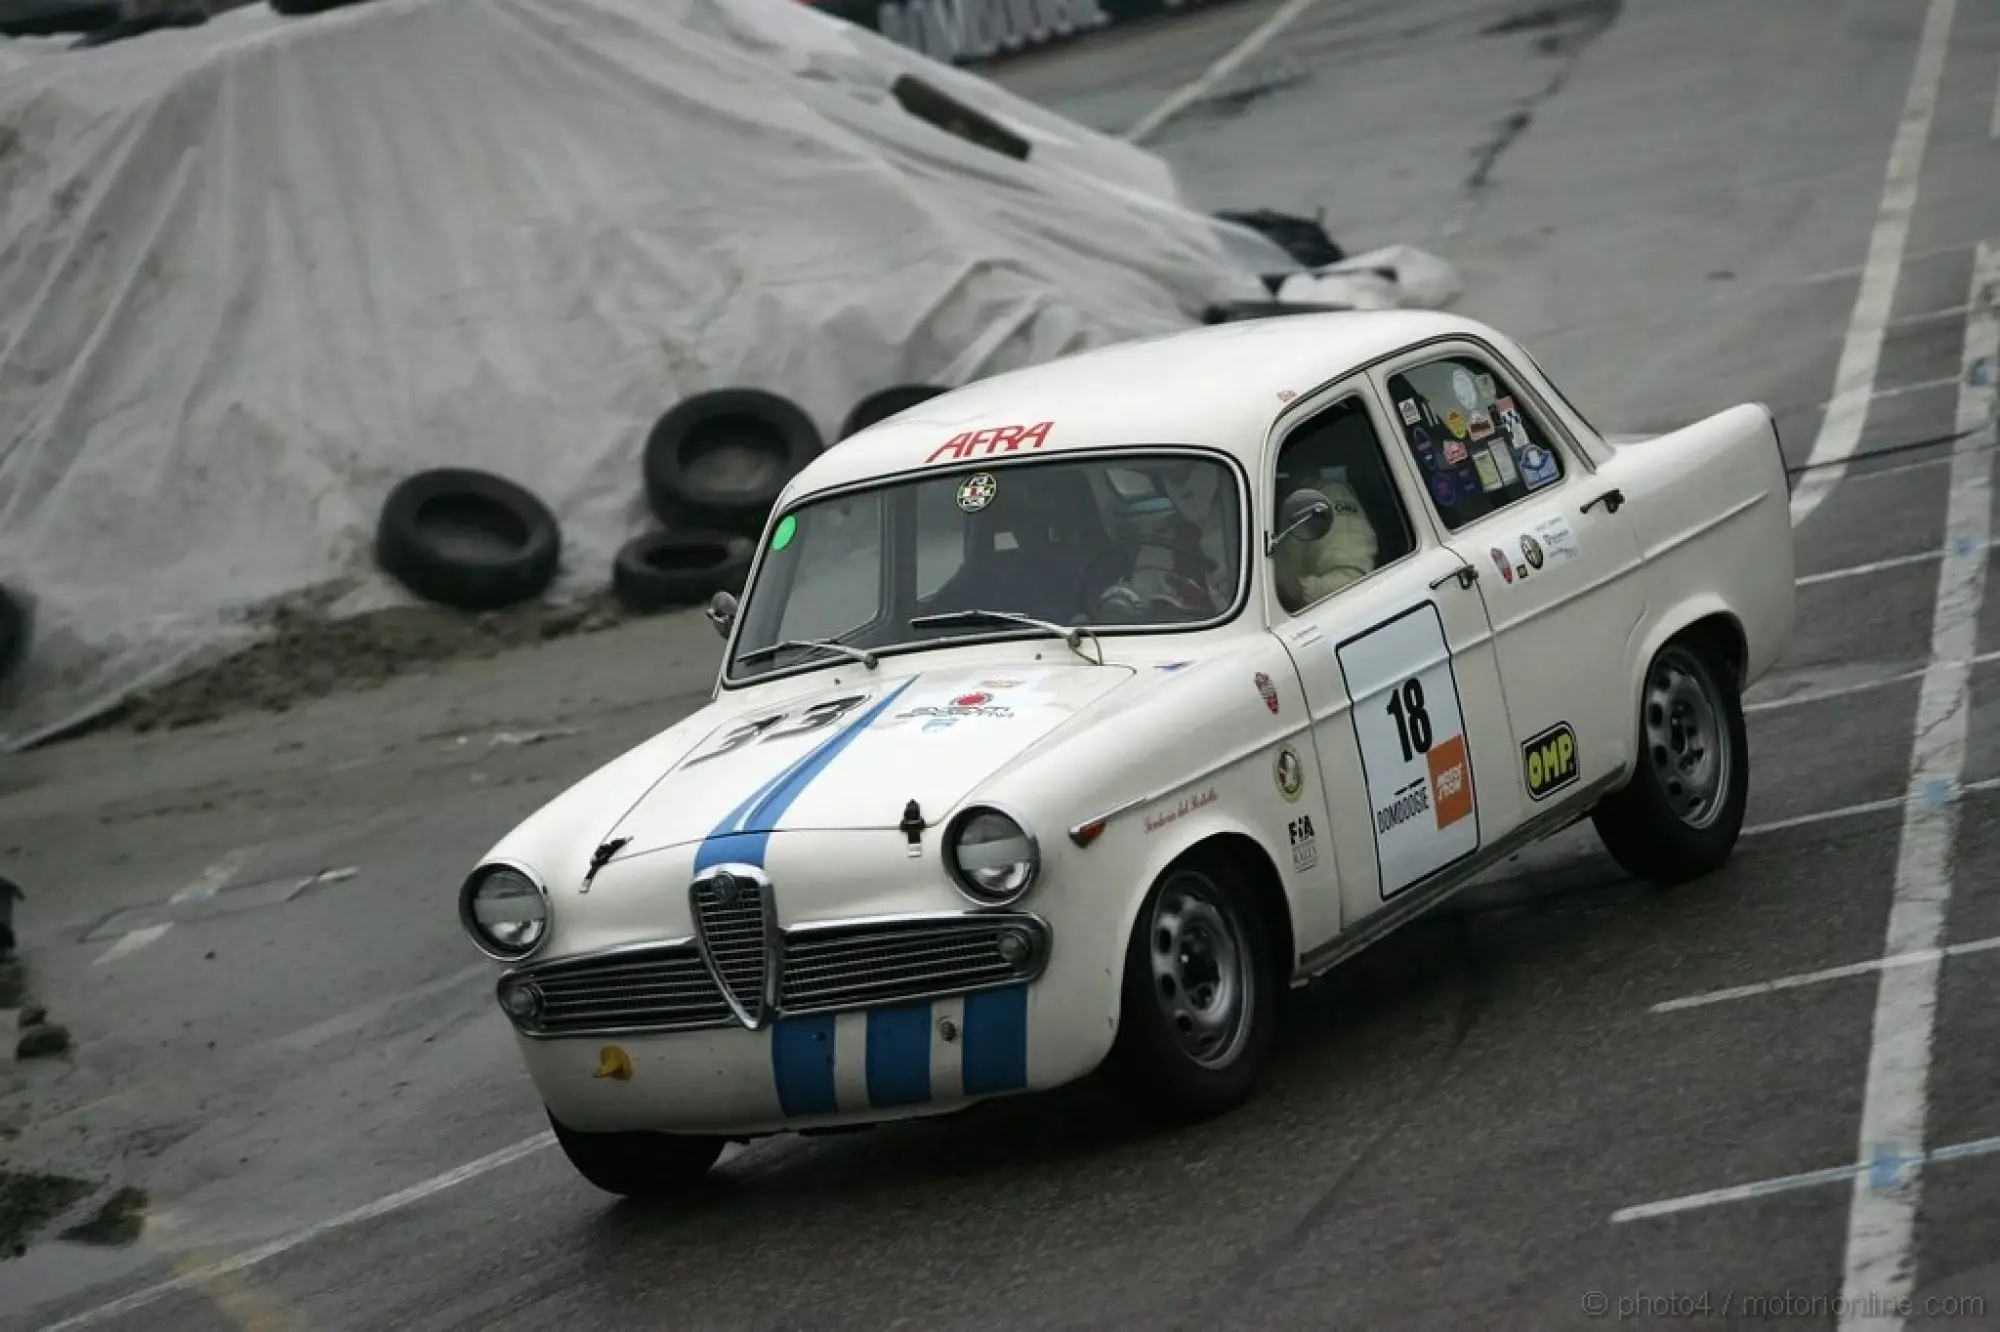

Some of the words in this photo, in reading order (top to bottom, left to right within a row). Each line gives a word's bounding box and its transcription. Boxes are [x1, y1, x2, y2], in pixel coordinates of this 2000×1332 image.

[924, 421, 1055, 464] AFRA
[1386, 677, 1433, 763] 18
[1528, 732, 1573, 789] OMP
